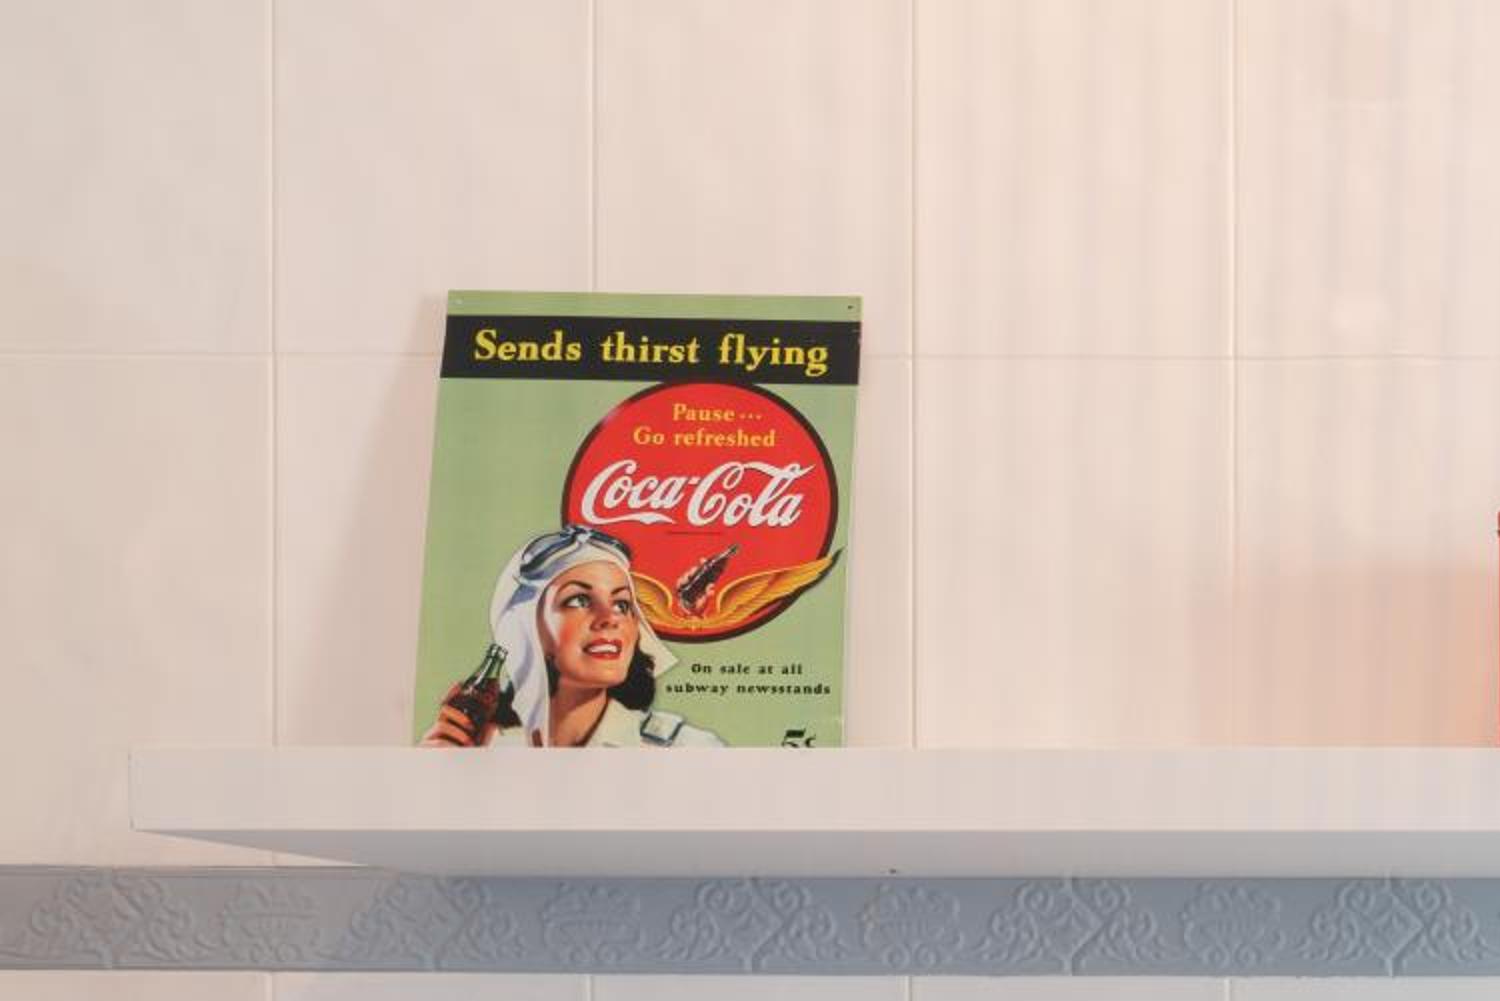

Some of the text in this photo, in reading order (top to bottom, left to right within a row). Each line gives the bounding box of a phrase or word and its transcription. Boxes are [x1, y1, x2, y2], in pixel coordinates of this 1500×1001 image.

[473, 328, 829, 377] Sends thirst flying
[633, 427, 776, 448] Go refreshed
[581, 458, 816, 528] Coca-Cola
[691, 663, 803, 675] On sale at all
[665, 683, 831, 696] subway newsstands
